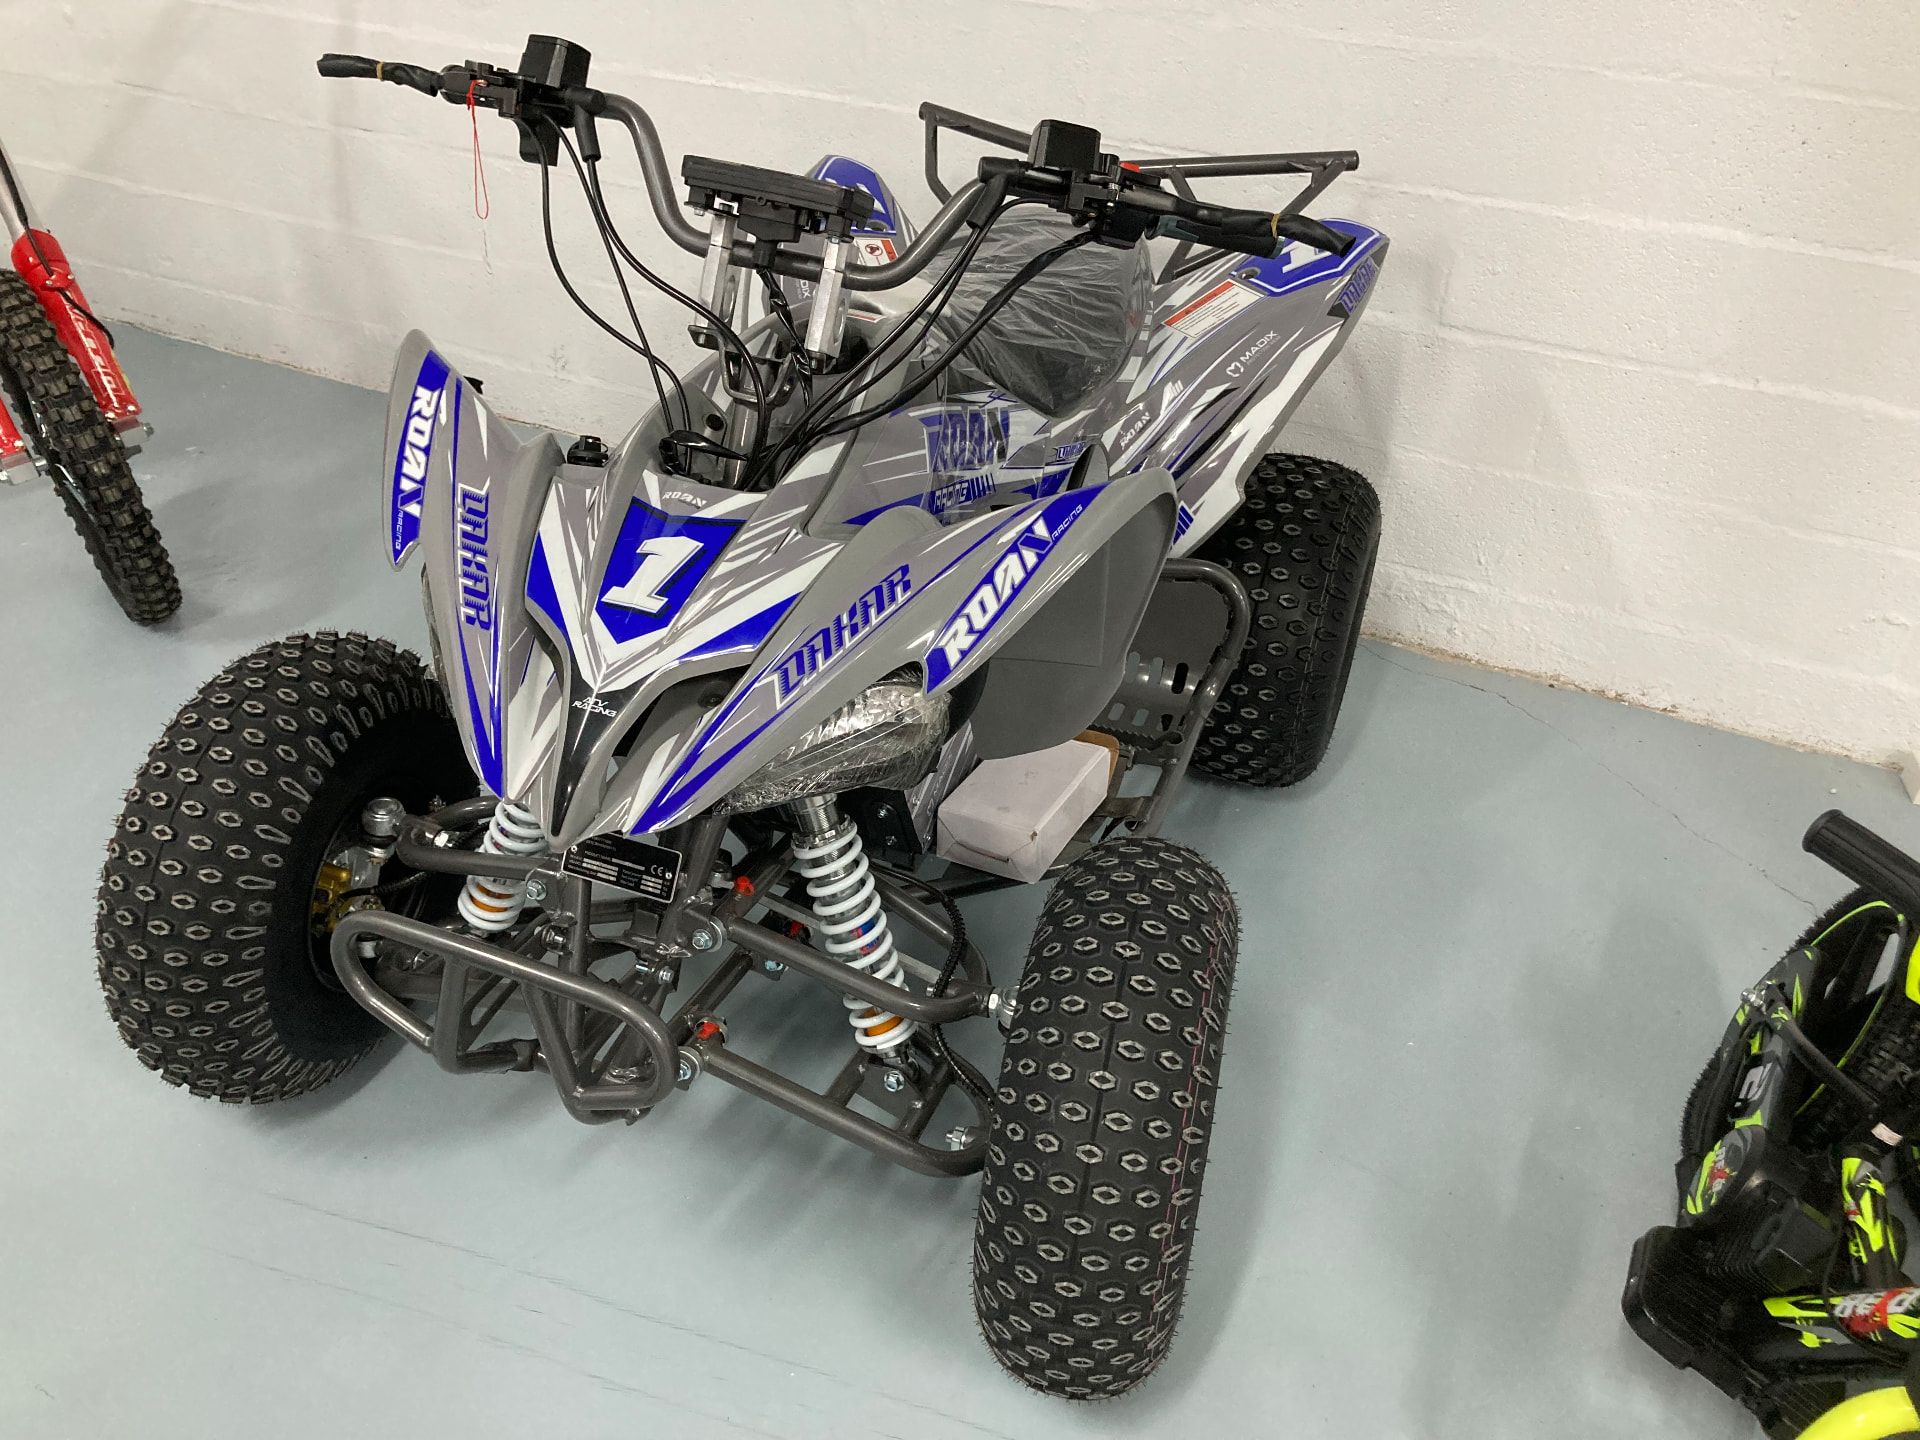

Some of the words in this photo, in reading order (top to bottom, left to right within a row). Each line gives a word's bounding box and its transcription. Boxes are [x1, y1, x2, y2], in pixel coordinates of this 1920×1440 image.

[1239, 330, 1279, 363] MADIX
[398, 385, 441, 519] ROAN
[395, 510, 405, 551] RACING
[662, 491, 708, 508] ROAN
[455, 477, 492, 632] DAKAR
[601, 536, 705, 617] 1
[938, 516, 1055, 670] ROAN
[1051, 504, 1084, 541] RACING
[763, 563, 913, 709] DAKAR
[571, 700, 618, 718] RACING
